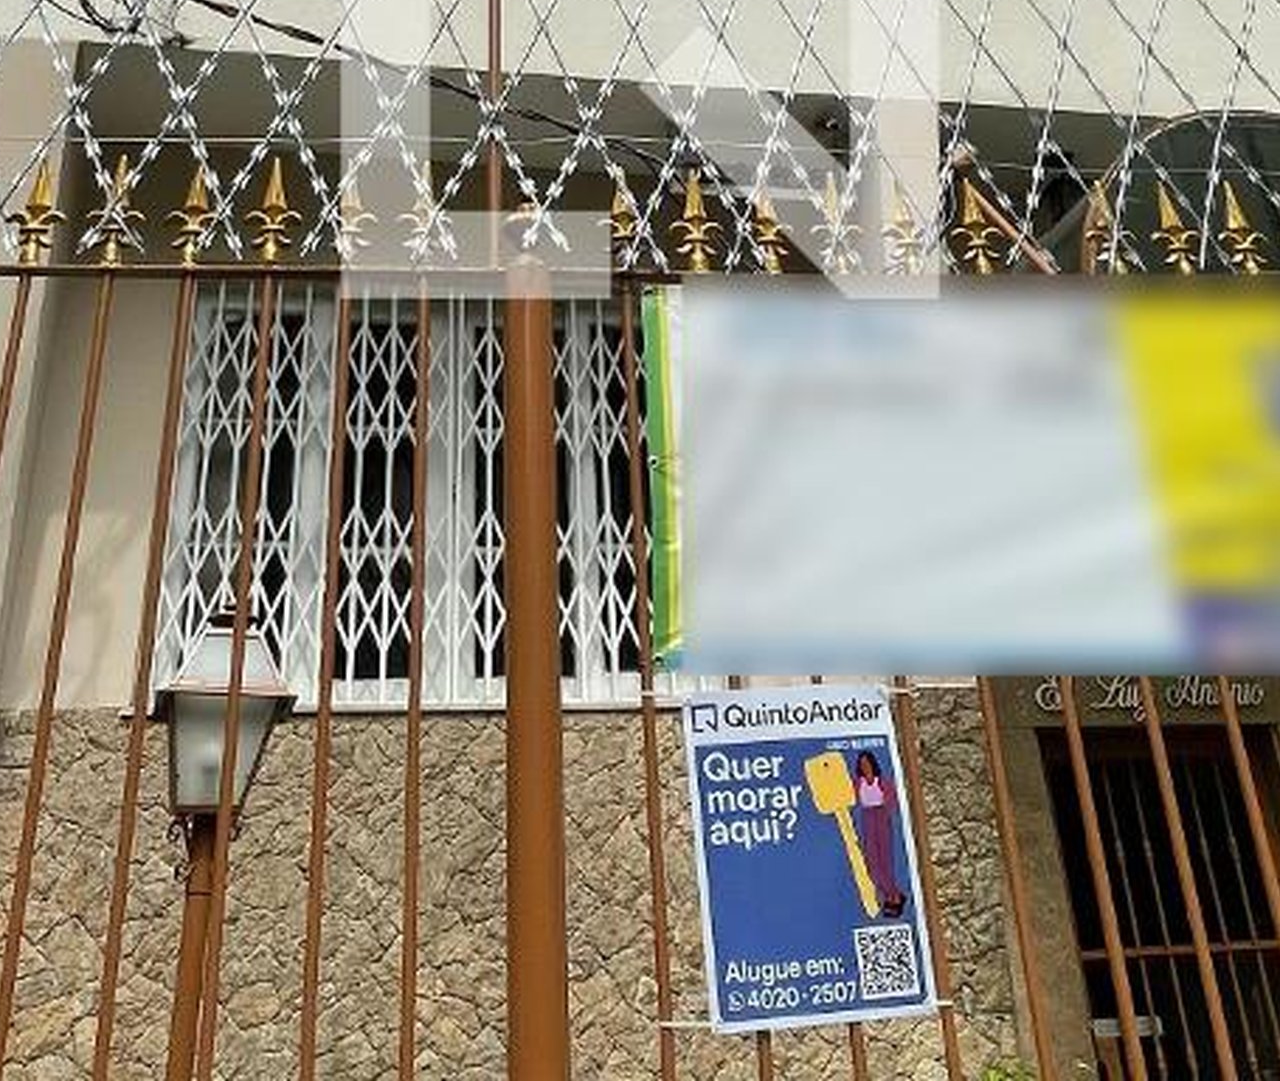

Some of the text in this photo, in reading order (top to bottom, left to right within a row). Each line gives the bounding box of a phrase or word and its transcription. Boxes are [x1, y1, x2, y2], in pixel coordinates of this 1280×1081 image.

[724, 699, 884, 728] QuintoAndar
[703, 752, 784, 781] Quer
[707, 785, 802, 814] morar
[710, 810, 798, 850] aqui?
[725, 956, 845, 987] Alugue em:
